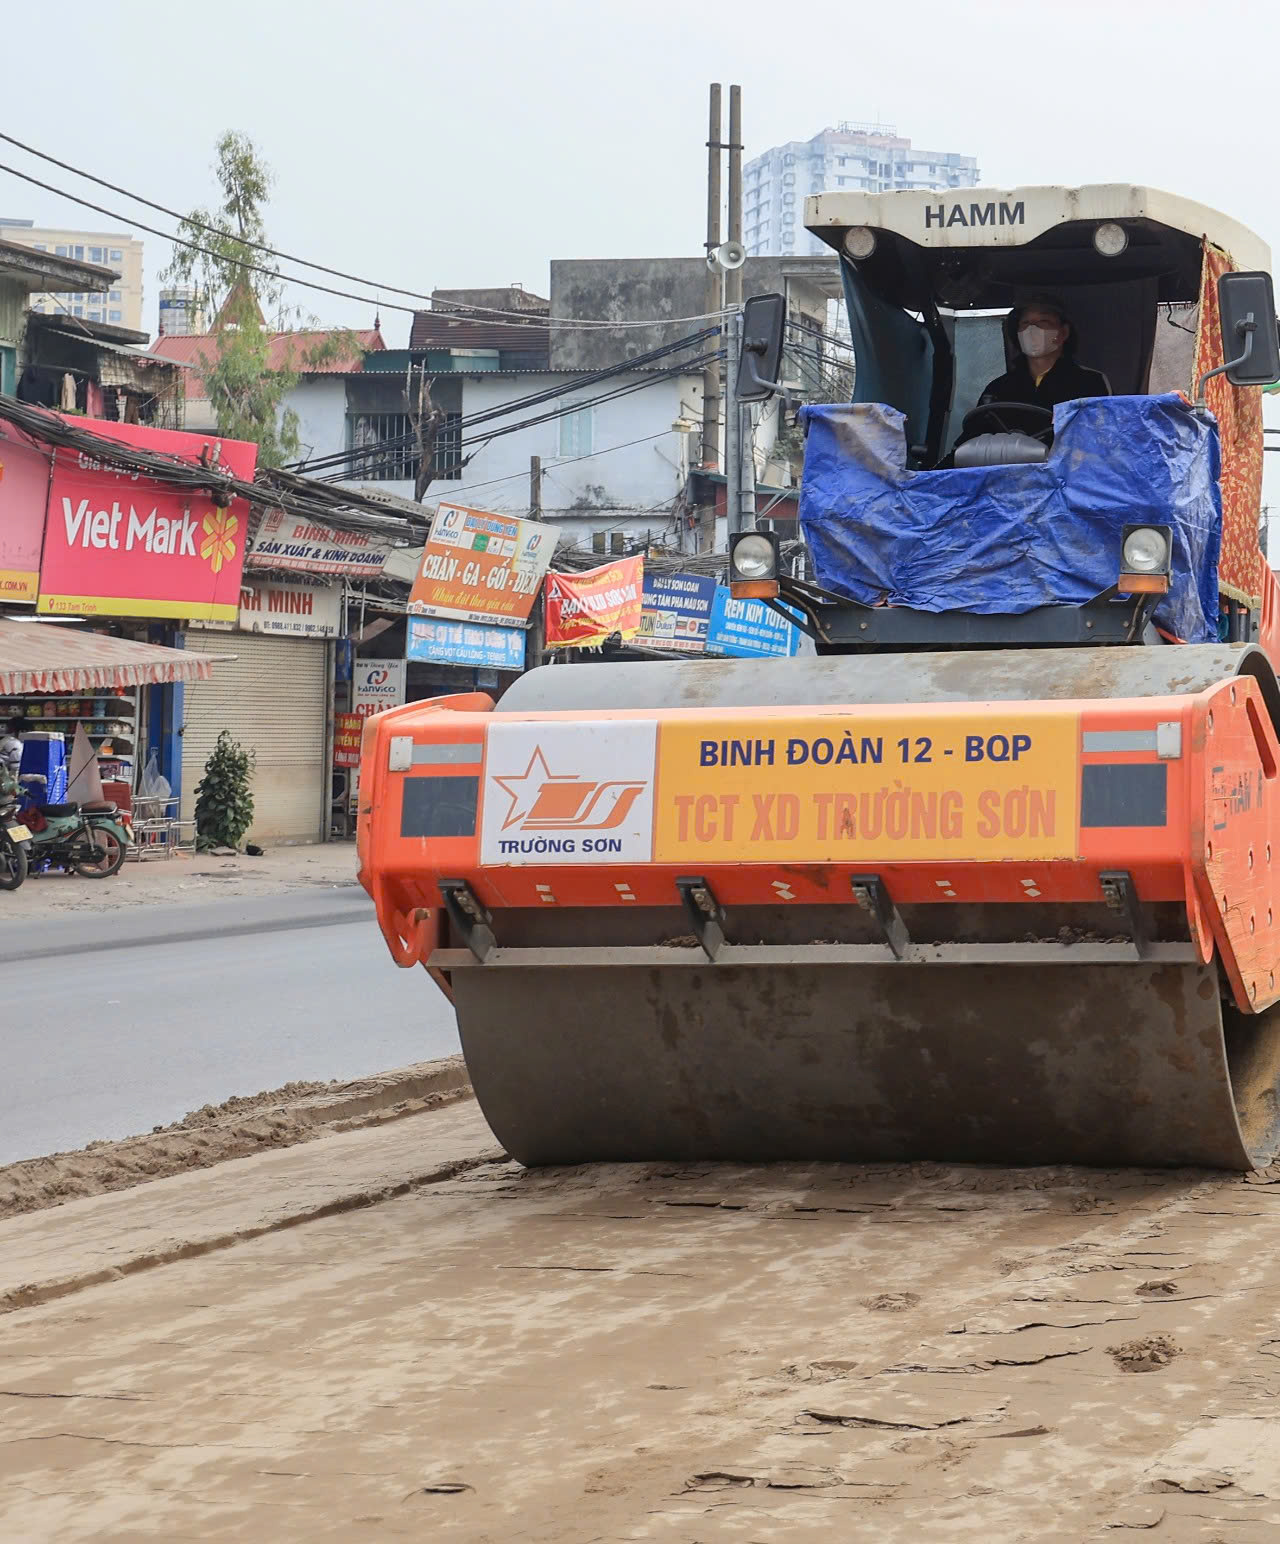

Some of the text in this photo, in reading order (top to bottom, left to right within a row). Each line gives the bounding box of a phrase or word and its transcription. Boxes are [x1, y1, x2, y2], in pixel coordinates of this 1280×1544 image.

[925, 201, 1025, 228] HAMM
[62, 497, 198, 556] Viet Mark
[333, 529, 372, 547] MINH
[256, 538, 386, 564] SẢN XUẤT & KINH DOANH
[421, 550, 459, 582] CHĂN
[462, 562, 480, 587] GA
[486, 558, 510, 591] GỐI
[268, 590, 313, 615] MINH
[745, 600, 763, 623] KIM
[699, 739, 776, 767] BINH
[785, 730, 884, 766] ĐOÀN
[896, 737, 933, 763] 12
[964, 734, 1033, 762] BQP
[673, 779, 1057, 843] TCT XD TRƯỜNG SƠN
[498, 836, 623, 854] TRƯỜNG SƠN
